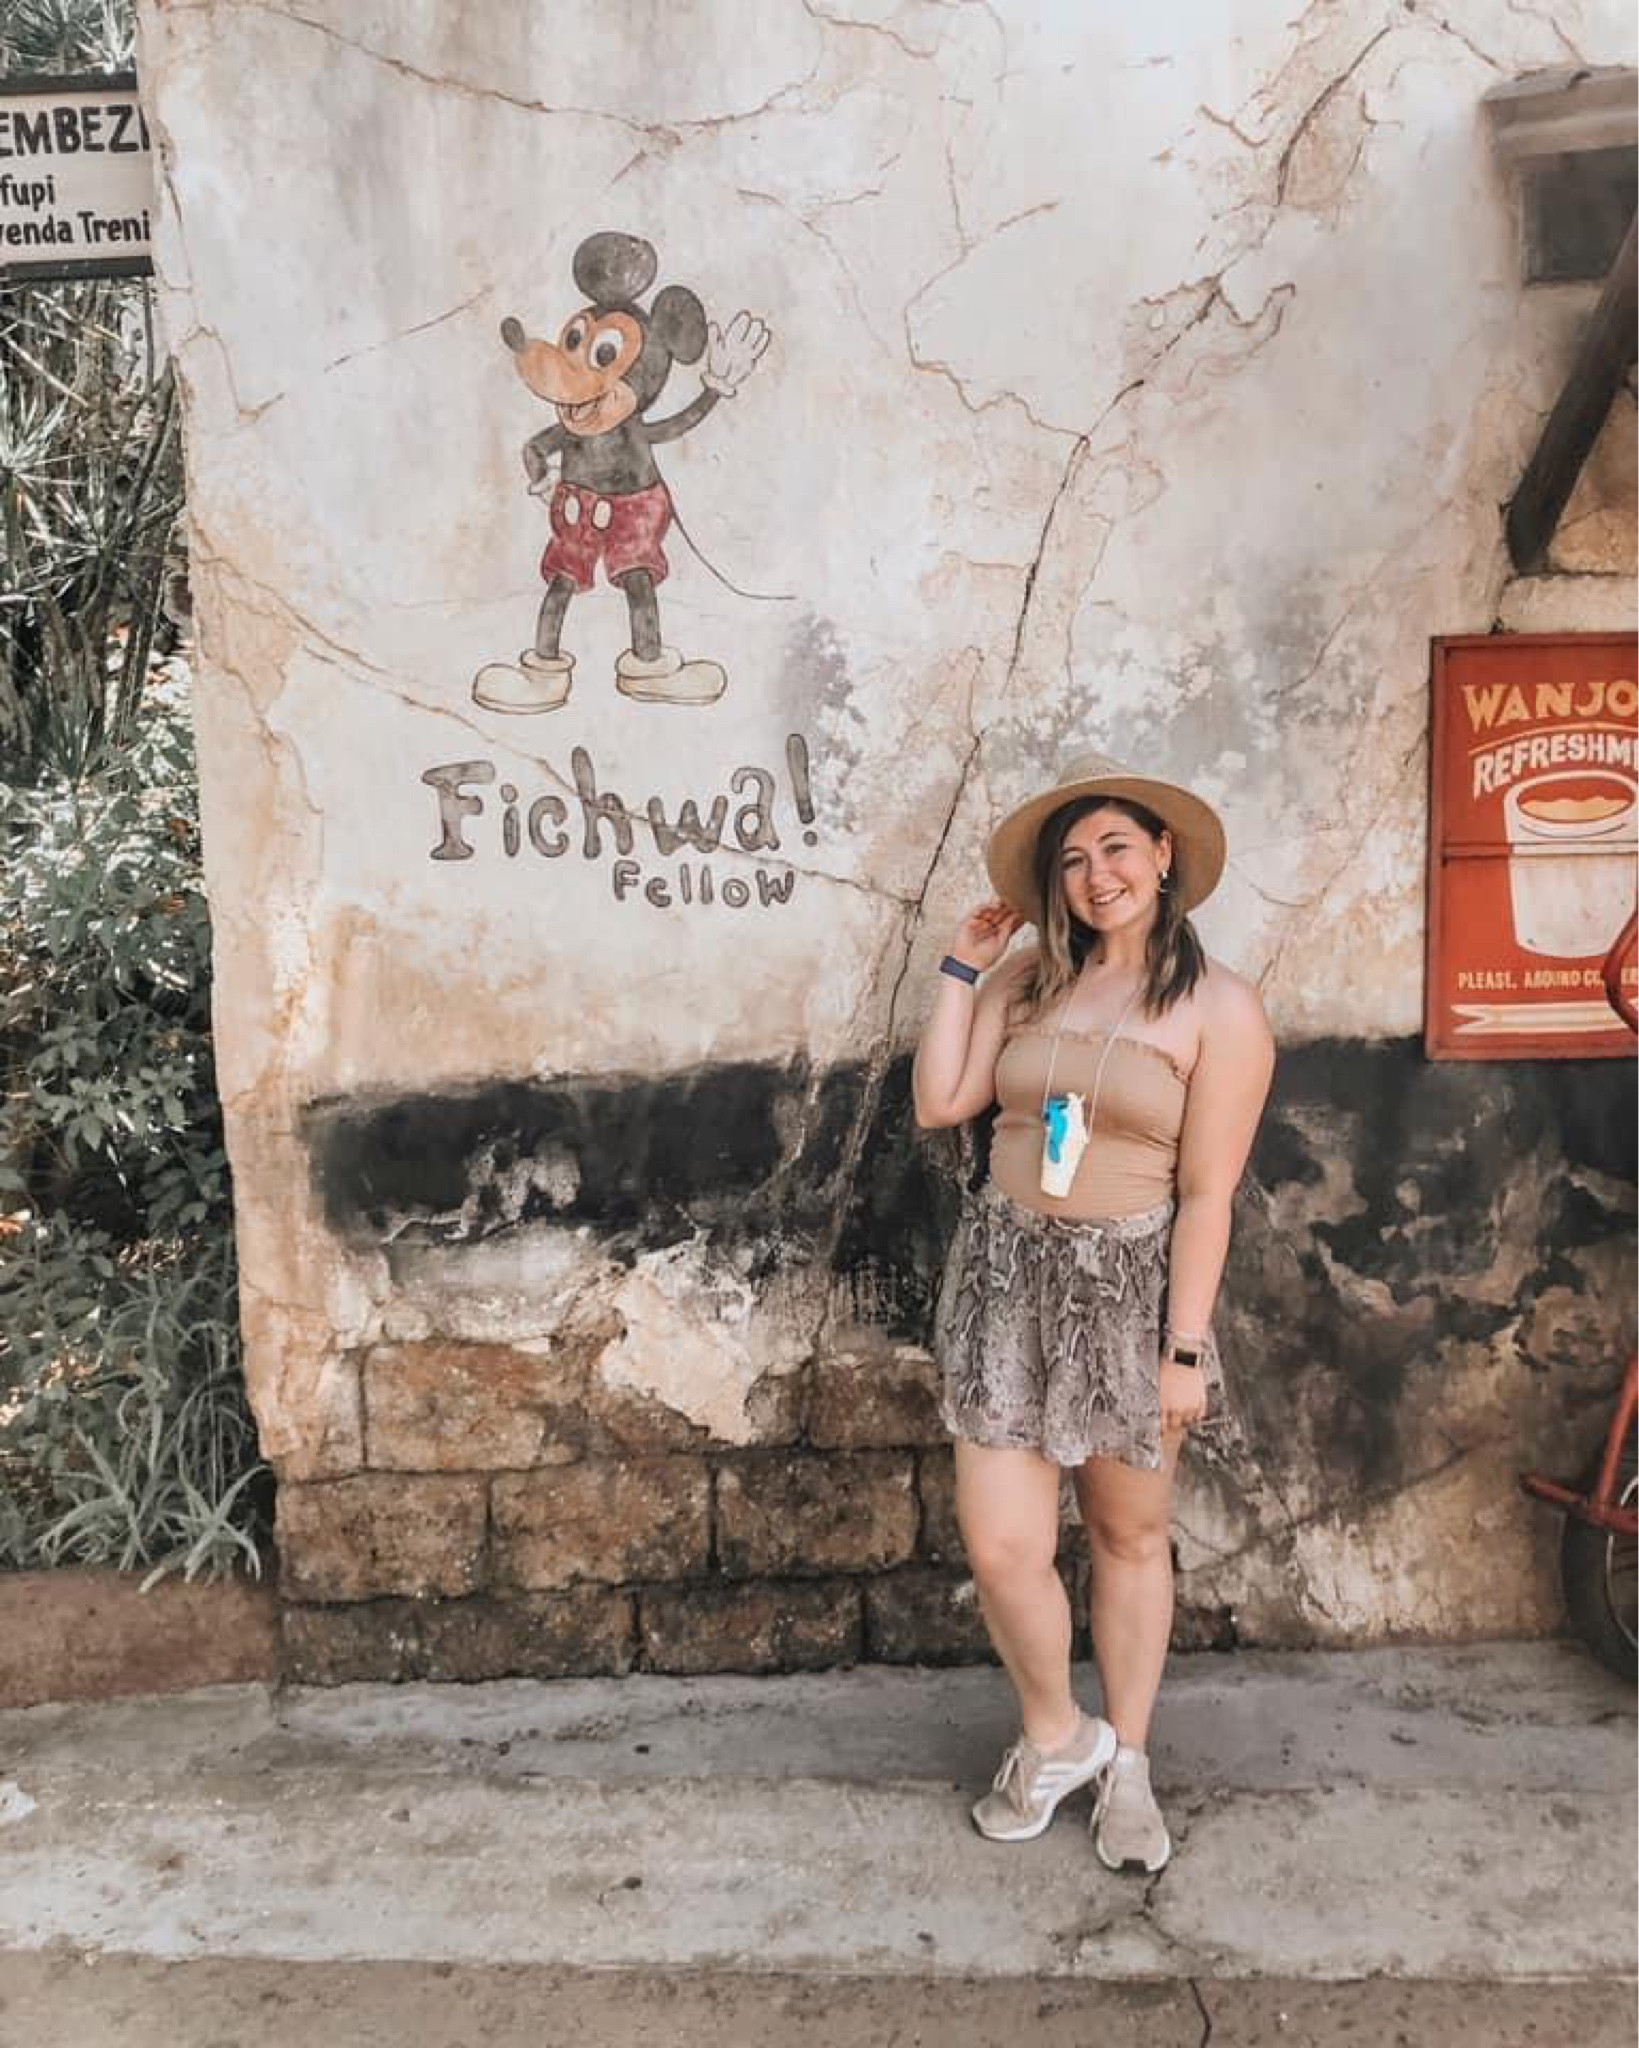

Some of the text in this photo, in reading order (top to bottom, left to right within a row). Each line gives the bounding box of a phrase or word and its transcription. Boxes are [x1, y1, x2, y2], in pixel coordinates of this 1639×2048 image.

[0, 174, 55, 212] fupi
[77, 209, 151, 243] Treni
[1461, 680, 1638, 734] WANJO
[1473, 733, 1638, 800] REFRESHM
[422, 734, 815, 860] Fichwa!
[613, 860, 794, 907] Fellow
